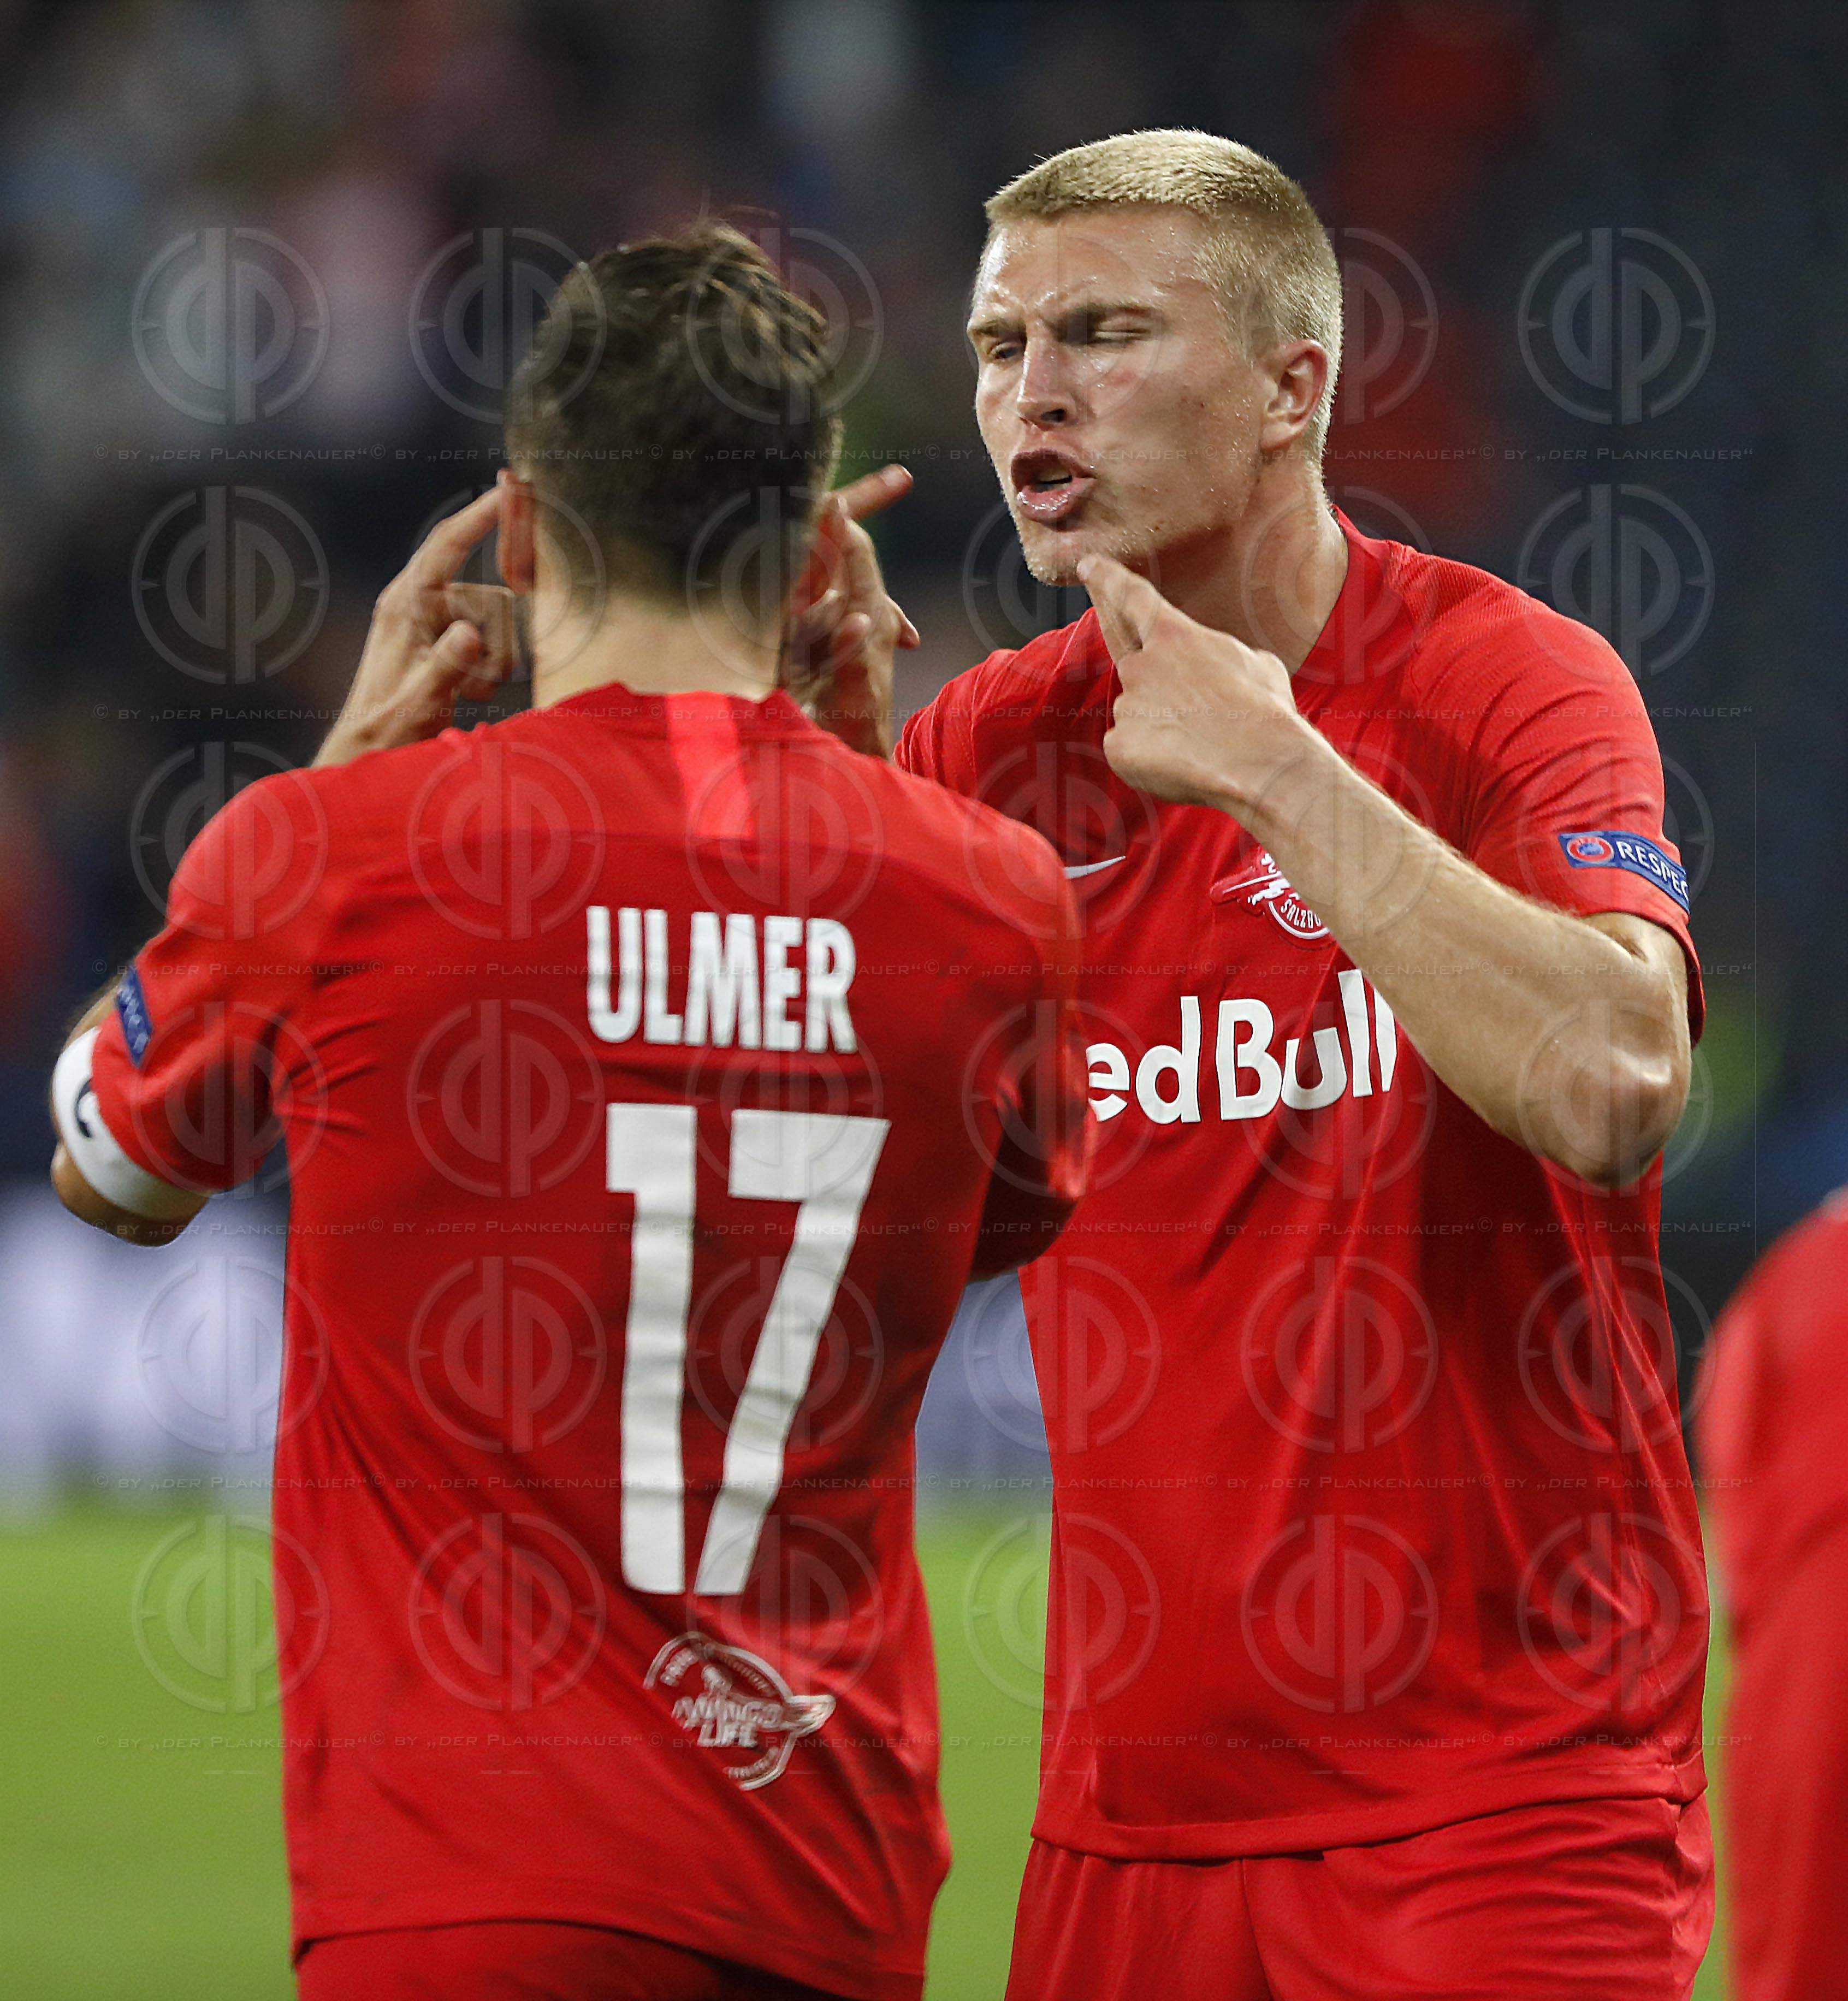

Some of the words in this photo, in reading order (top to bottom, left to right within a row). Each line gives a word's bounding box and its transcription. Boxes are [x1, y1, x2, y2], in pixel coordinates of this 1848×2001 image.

[1281, 898, 1322, 929] SALZBU
[1616, 841, 1690, 901] RESPEC
[587, 905, 857, 1054] ULMER
[1086, 996, 1201, 1124] ed
[606, 1103, 891, 1595] 17
